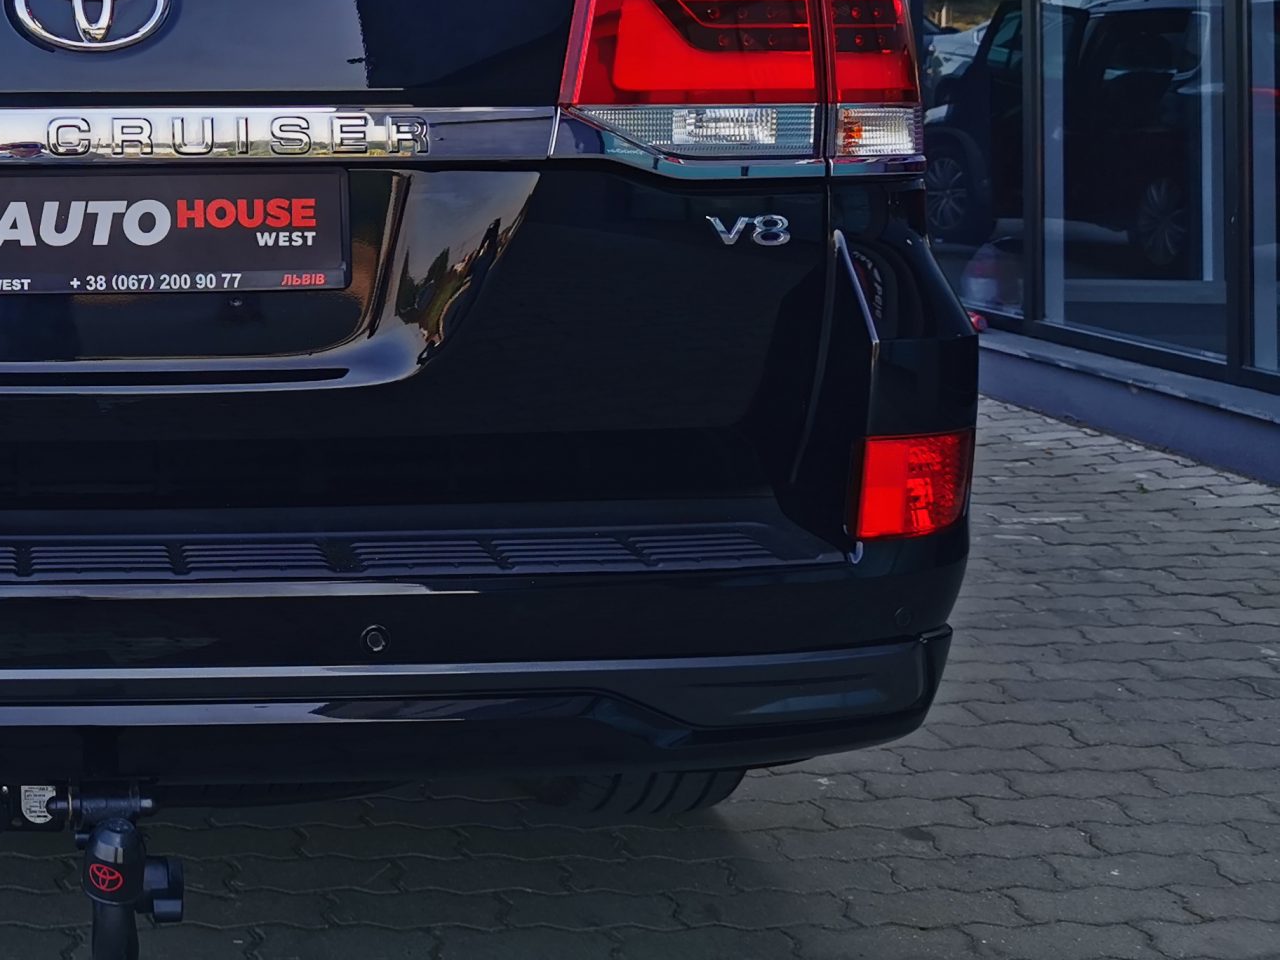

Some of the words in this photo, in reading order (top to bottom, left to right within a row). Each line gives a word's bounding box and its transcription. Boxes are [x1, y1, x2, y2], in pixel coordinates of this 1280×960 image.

[45, 115, 431, 156] CRUISER
[705, 214, 791, 246] V8
[256, 231, 317, 247] WEST
[111, 274, 155, 290] (067)
[159, 274, 191, 289] 200
[195, 273, 217, 289] 90
[221, 273, 242, 288] 77
[281, 273, 327, 286] ЛЬВІВ
